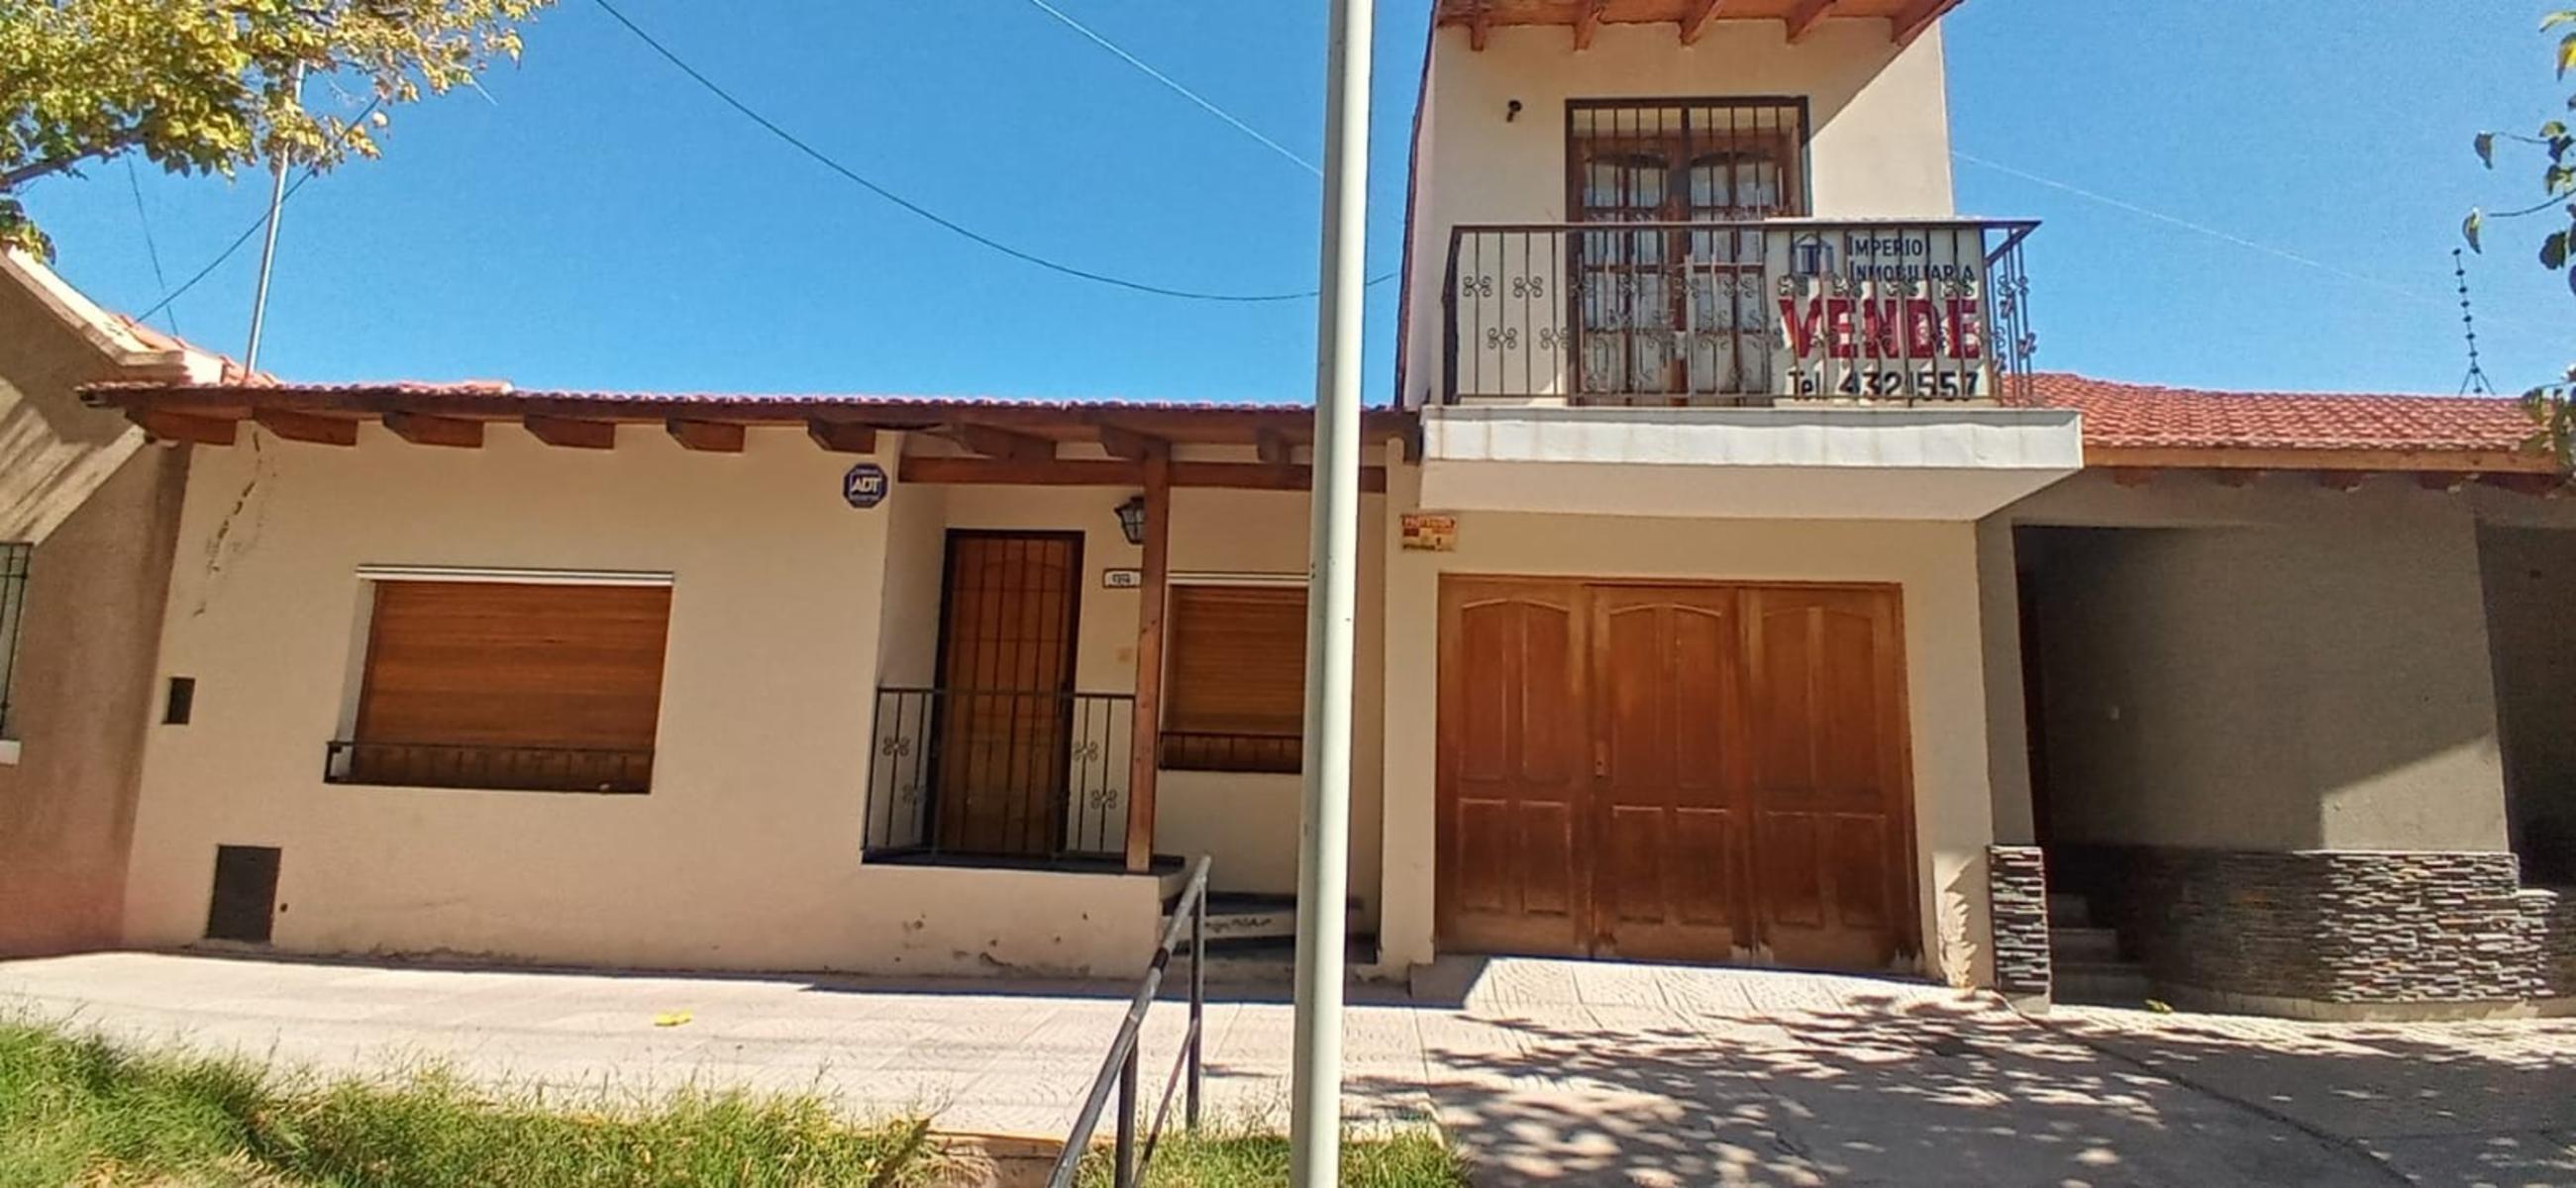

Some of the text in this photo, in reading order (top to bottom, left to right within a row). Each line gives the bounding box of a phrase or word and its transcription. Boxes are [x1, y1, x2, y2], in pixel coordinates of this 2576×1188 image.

[1848, 236, 1923, 257] IMPERIO
[1778, 299, 1981, 358] VENDE
[851, 476, 882, 493] ADT
